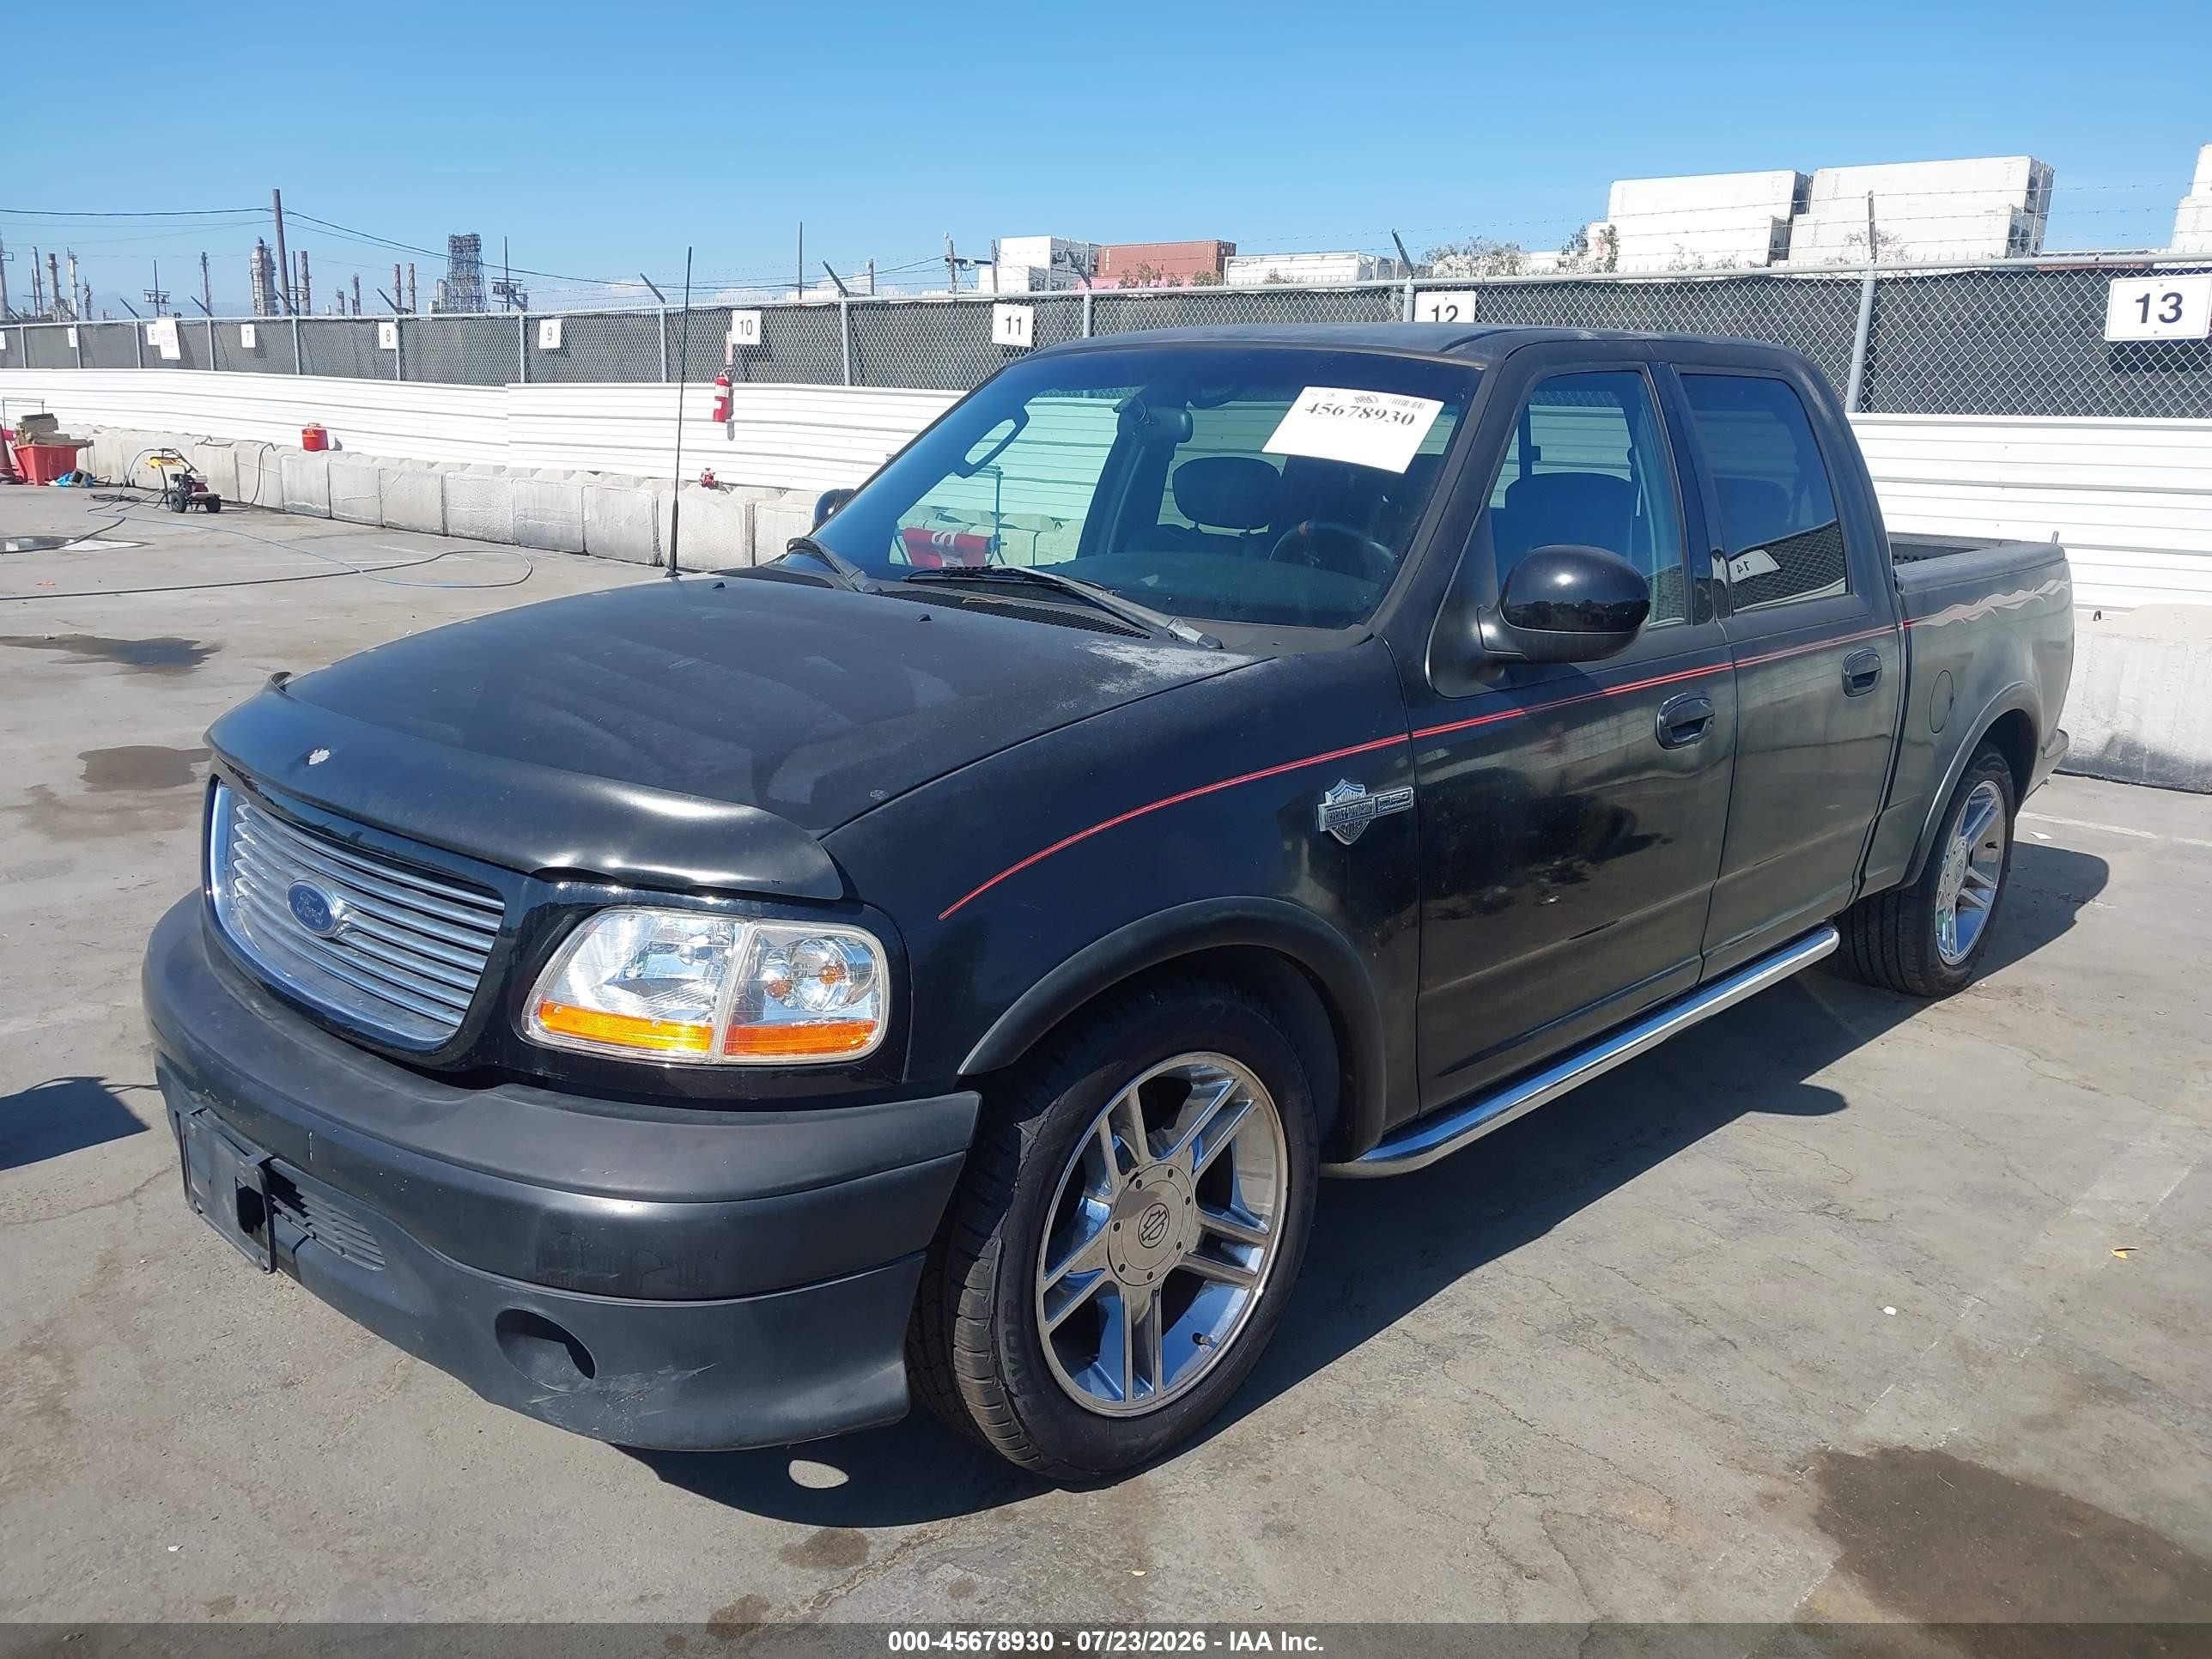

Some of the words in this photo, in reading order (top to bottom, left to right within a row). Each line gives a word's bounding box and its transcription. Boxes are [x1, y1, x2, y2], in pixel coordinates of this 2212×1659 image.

[1431, 304, 1459, 322] 12
[2135, 291, 2184, 324] 13
[546, 326, 553, 341] 9
[738, 319, 753, 337] 10
[1005, 314, 1022, 336] 11
[386, 329, 392, 343] 8
[1304, 401, 1415, 426] 45678930
[296, 890, 325, 925] Ford
